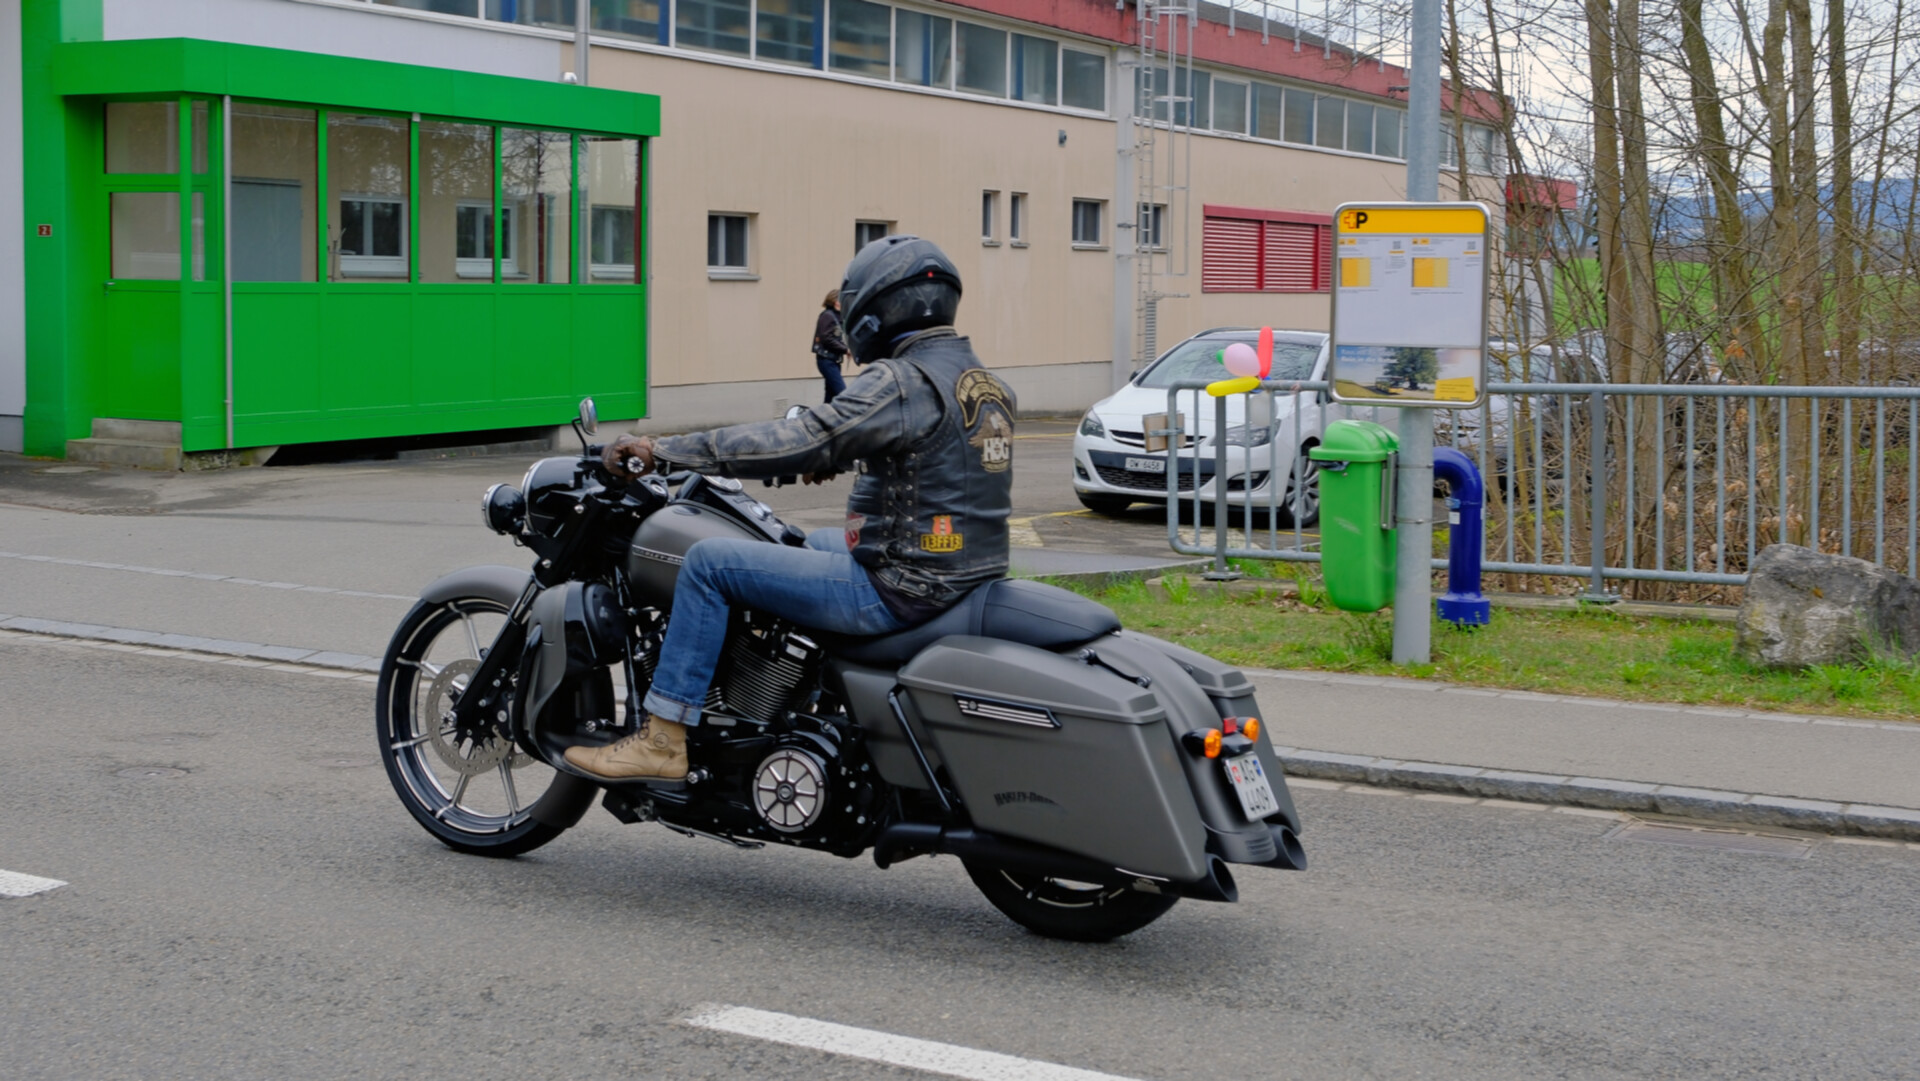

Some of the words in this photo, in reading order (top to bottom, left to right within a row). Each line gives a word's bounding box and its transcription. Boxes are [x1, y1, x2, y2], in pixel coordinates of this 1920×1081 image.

[984, 437, 1009, 461] HOG
[1239, 759, 1256, 784] AG
[1246, 785, 1271, 815] 4409
